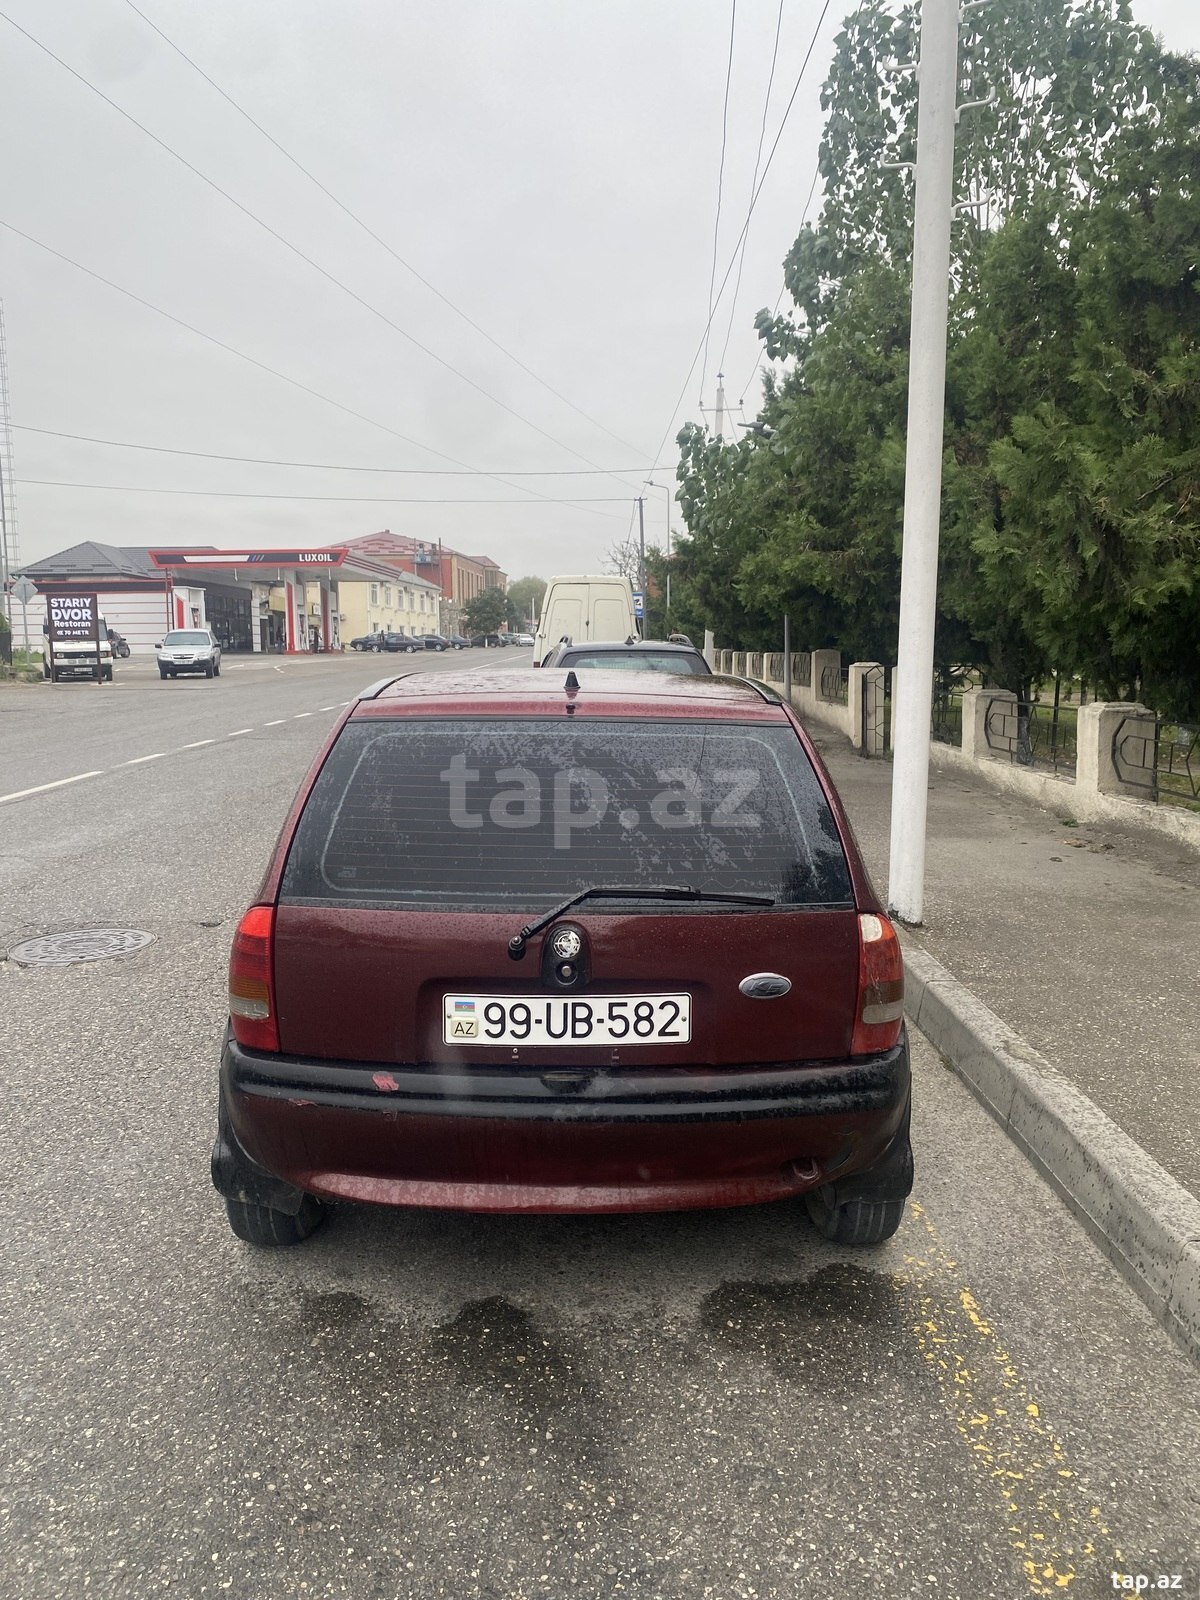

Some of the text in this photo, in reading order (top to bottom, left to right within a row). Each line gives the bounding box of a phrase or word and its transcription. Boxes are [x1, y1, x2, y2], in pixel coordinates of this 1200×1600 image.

[299, 553, 333, 562] LUXOIL
[50, 598, 91, 607] STARIY
[51, 609, 92, 620] DVOR
[54, 620, 91, 628] Restoran
[484, 1001, 680, 1039] 99-UB-582
[454, 1022, 475, 1035] AZ
